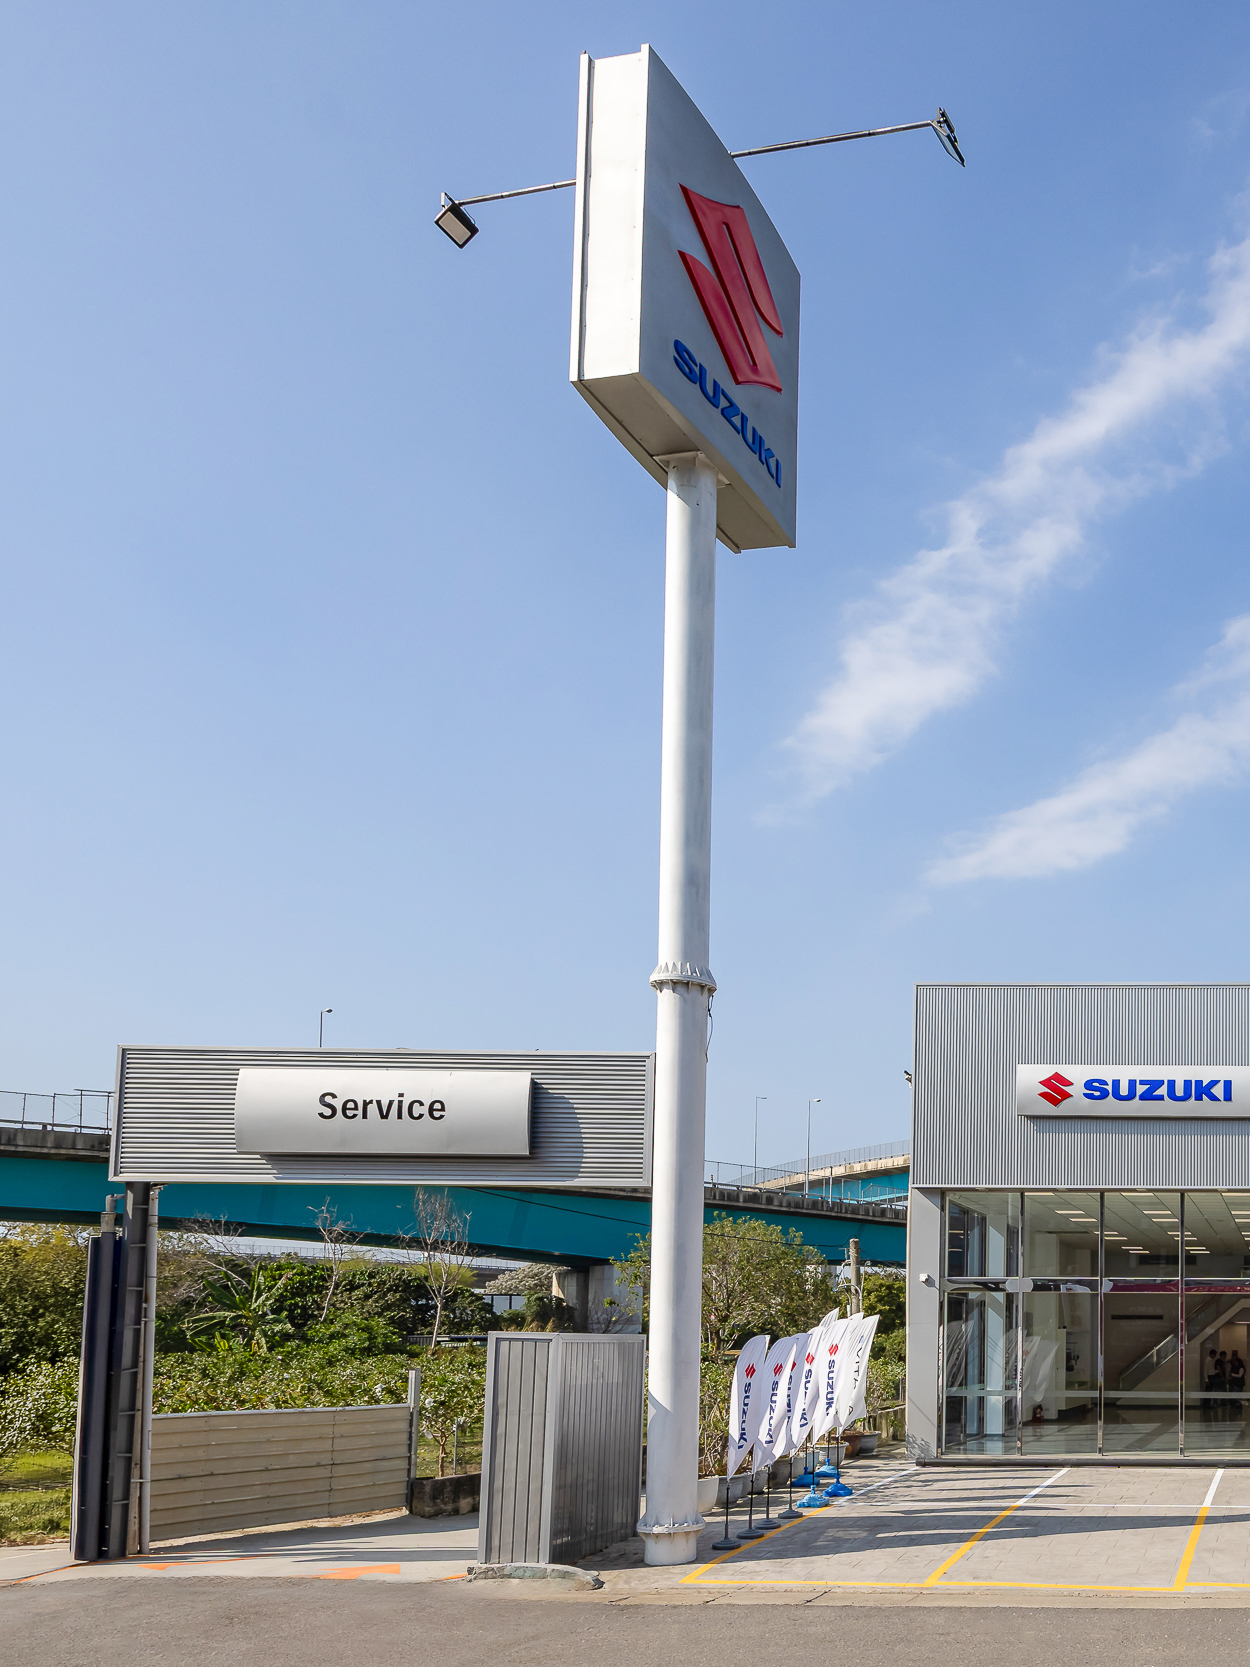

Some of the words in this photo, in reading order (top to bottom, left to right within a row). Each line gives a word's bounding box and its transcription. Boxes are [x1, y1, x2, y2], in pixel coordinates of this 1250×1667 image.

[673, 339, 782, 489] SUZUKI
[317, 1091, 446, 1121] Service
[1082, 1078, 1233, 1102] SUZUKI
[800, 1368, 812, 1428] SUKI
[849, 1347, 863, 1416] VITAA
